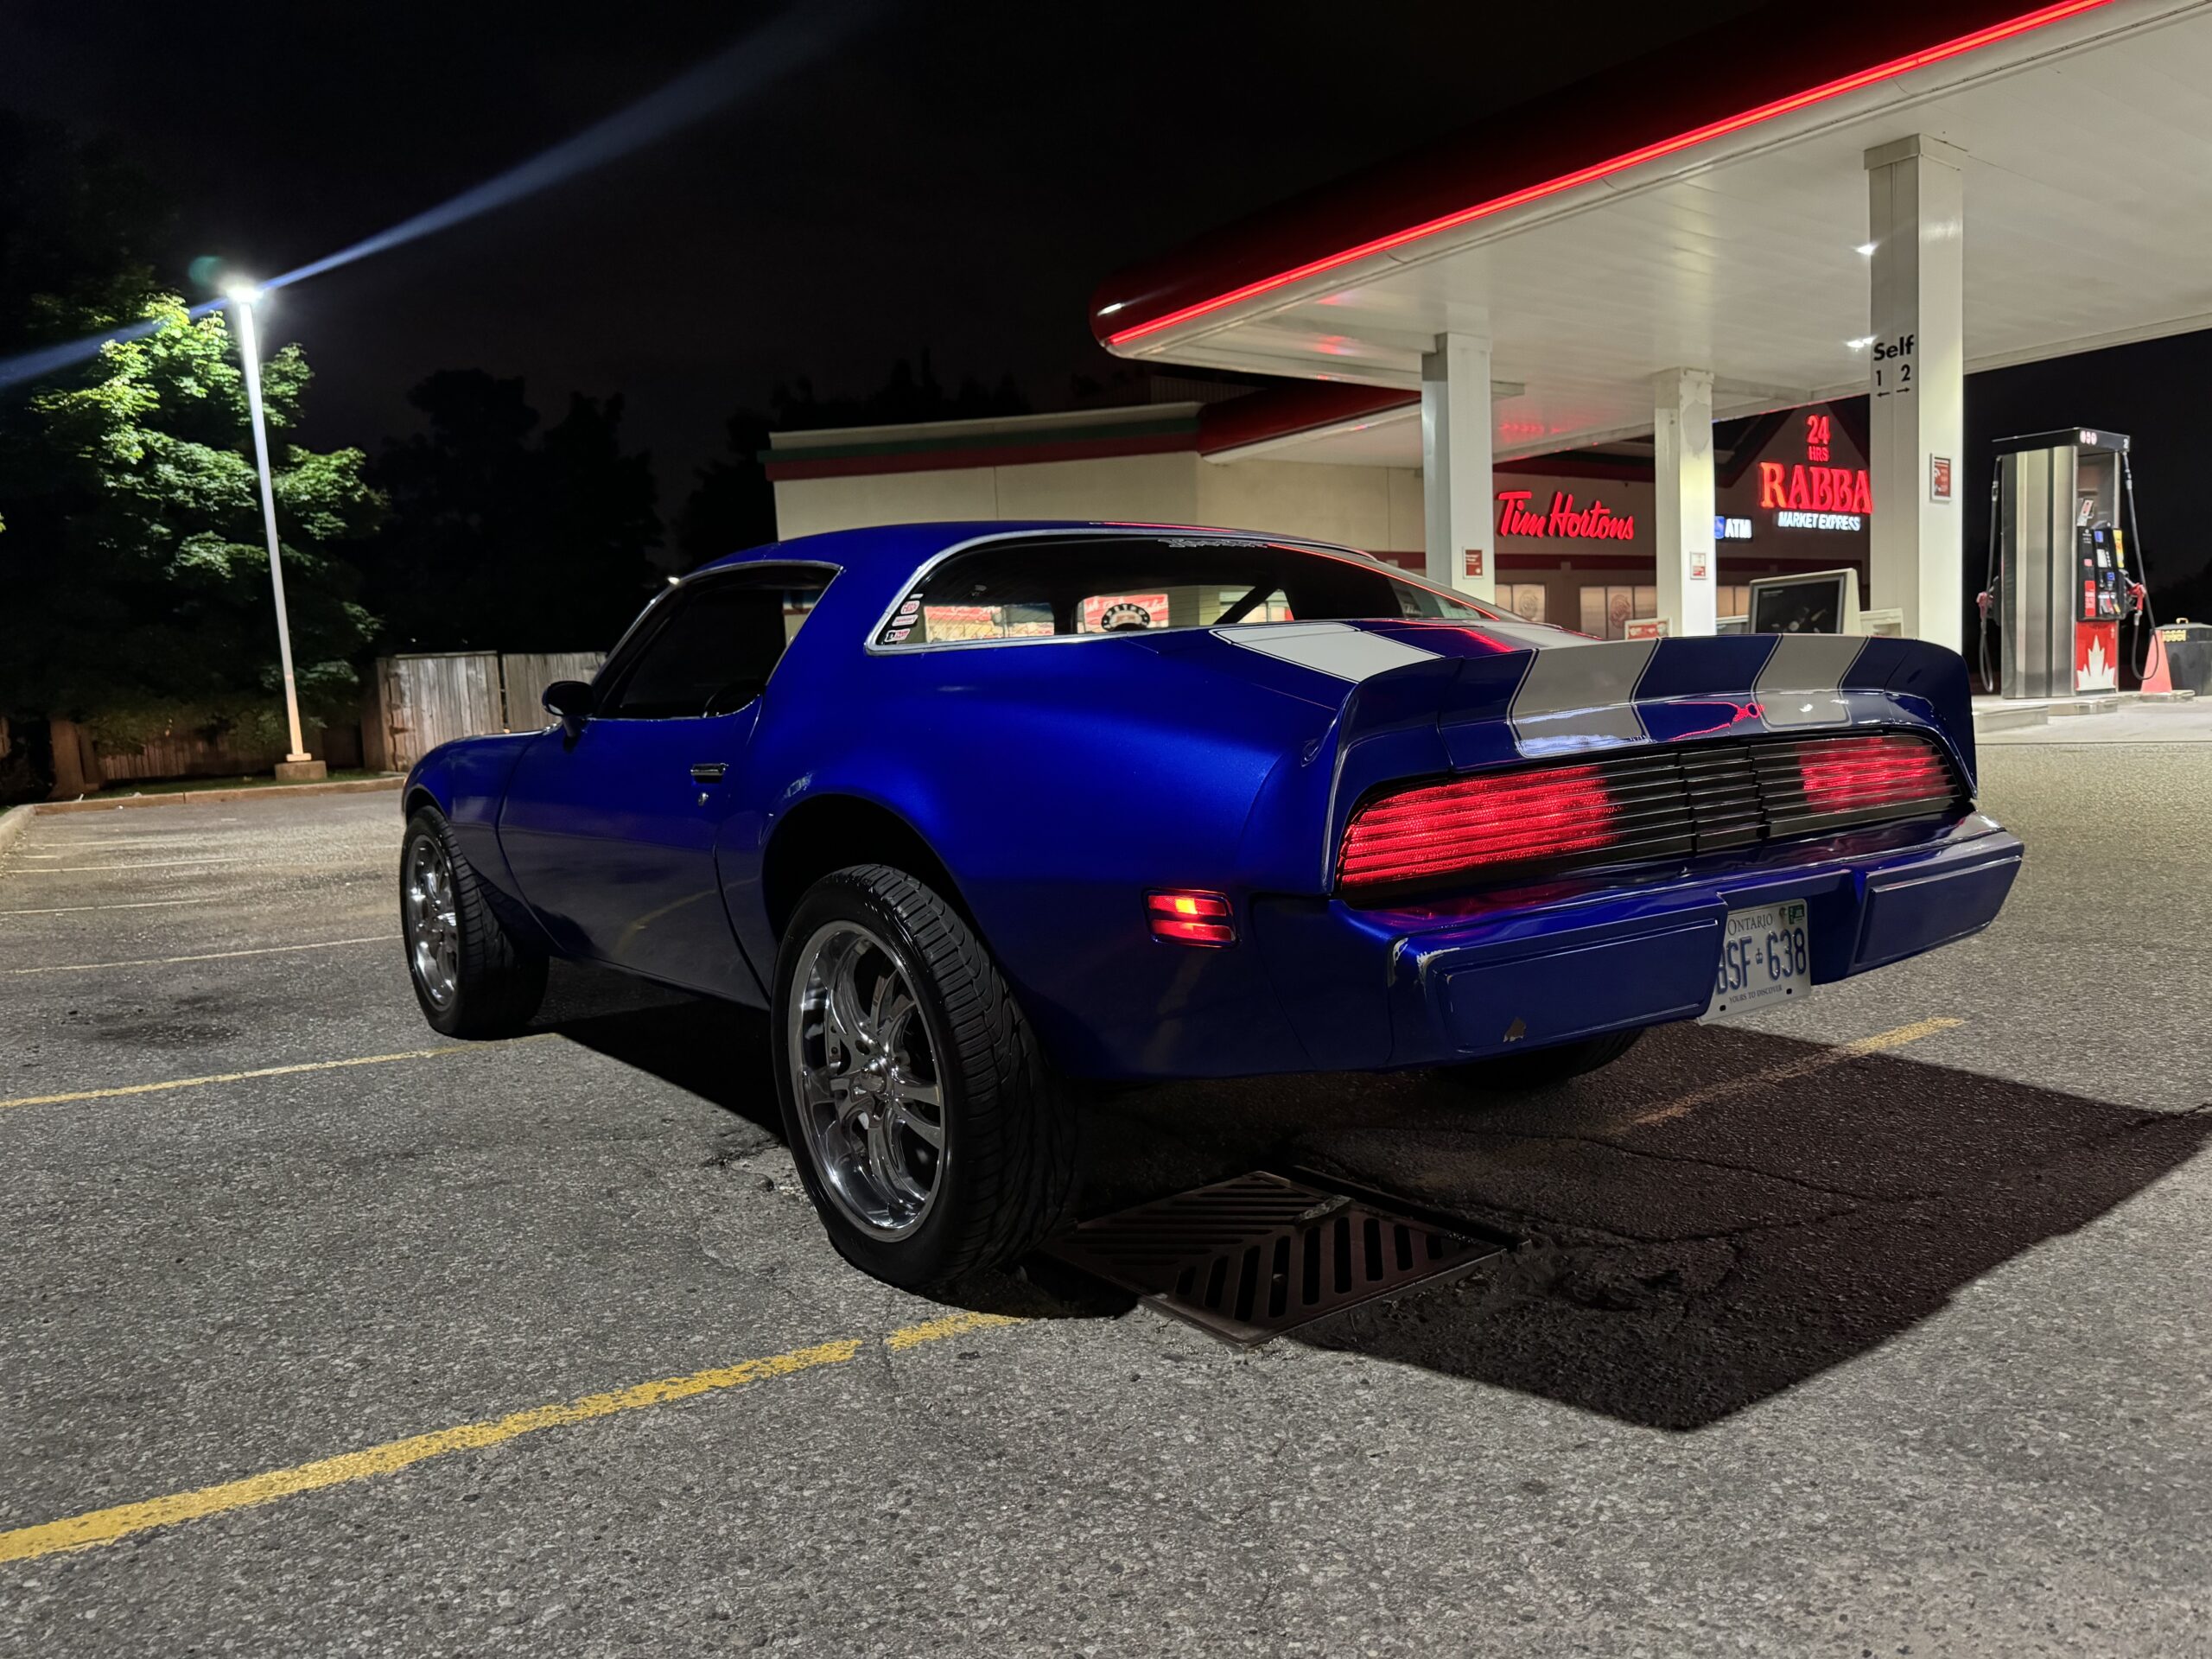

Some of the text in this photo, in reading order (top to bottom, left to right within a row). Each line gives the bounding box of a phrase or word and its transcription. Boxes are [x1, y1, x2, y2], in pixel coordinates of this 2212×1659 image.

[1873, 334, 1914, 361] Self
[1876, 364, 1910, 386] 1 2
[1806, 414, 1831, 445] 24
[1808, 445, 1830, 462] HRS
[1758, 461, 1873, 515] RABBA
[1497, 490, 1635, 540] Tim Hortons
[1777, 511, 1861, 531] MARKET EXPRESS
[1725, 518, 1752, 539] ATM
[1728, 912, 1774, 937] ONTARIO
[1767, 927, 1807, 981] 638
[1729, 984, 1783, 1004] YOURS TO DISCOVER
